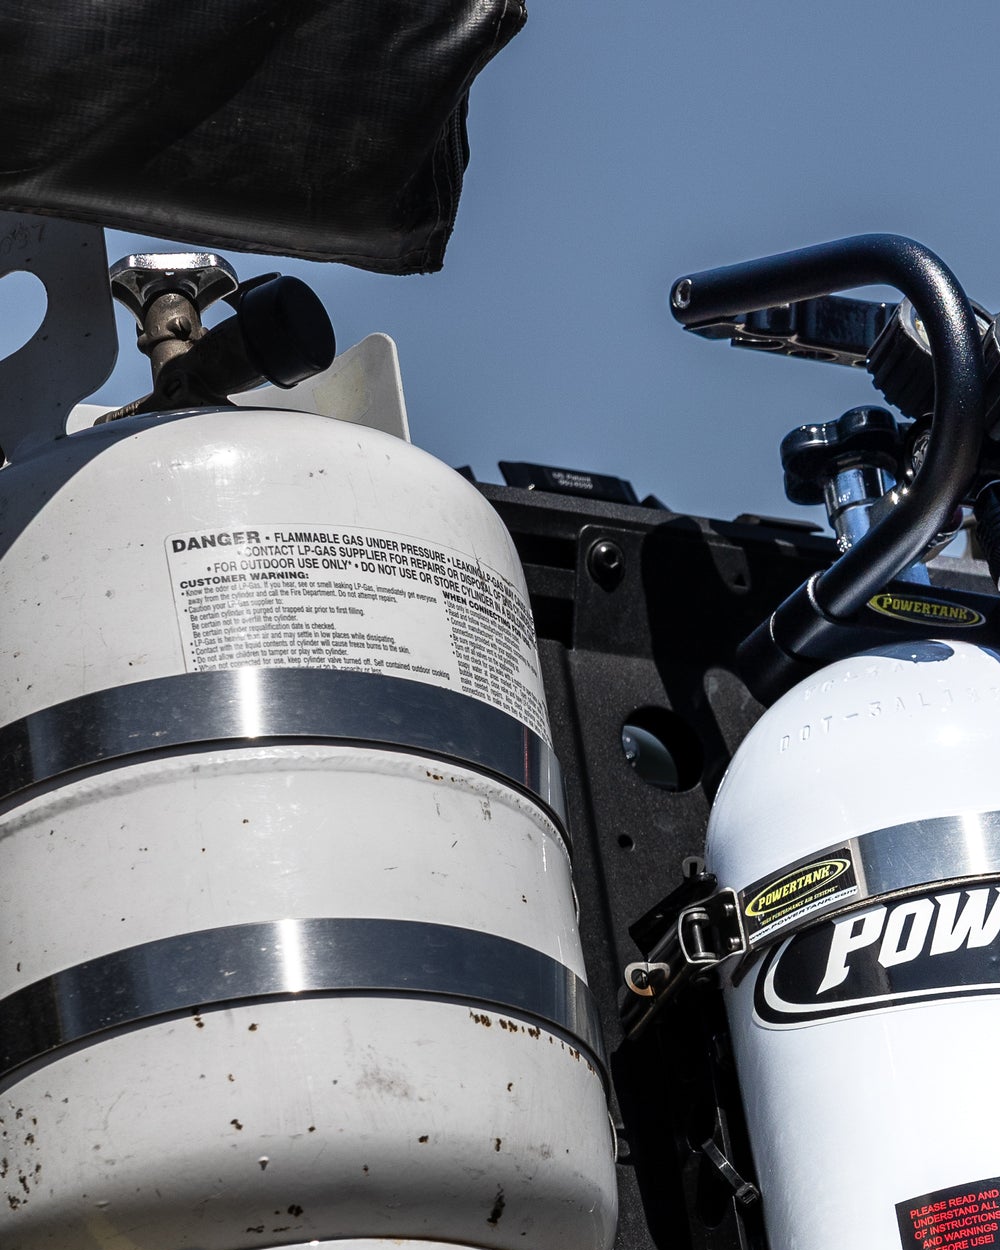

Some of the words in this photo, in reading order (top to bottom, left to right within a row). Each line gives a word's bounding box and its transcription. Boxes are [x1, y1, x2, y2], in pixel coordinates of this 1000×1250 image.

[172, 530, 261, 553] DANGER
[274, 532, 340, 544] FLAMMABLE
[342, 534, 364, 546] GAS
[365, 537, 399, 552] UNDER
[400, 542, 446, 564] PRESSURE
[245, 545, 294, 557] CONTACT
[297, 545, 337, 557] LP-GAS
[339, 547, 388, 563] SUPPLIER
[389, 553, 408, 566] FOR
[411, 557, 446, 576] REPAIRS
[447, 567, 459, 580] OR
[180, 573, 247, 589] CUSTOMER
[250, 571, 309, 580] WARNING:
[213, 561, 237, 573] FOR
[240, 558, 295, 570] OUTDOOR
[298, 558, 320, 569] USE
[361, 561, 376, 573] DO
[377, 564, 397, 577] NOT
[399, 568, 418, 581] USE
[420, 572, 432, 584] OR
[433, 575, 461, 594] STORE
[334, 581, 353, 591] leaking
[290, 588, 301, 596] Fire
[302, 588, 337, 598] Department.
[442, 590, 467, 605] WHEN
[882, 597, 968, 620] POWERTANK
[758, 864, 831, 911] POWERTANK
[910, 1201, 947, 1219] PLEASE
[949, 1194, 976, 1207] READ
[978, 1189, 1000, 1201] AND
[914, 1204, 979, 1229] UNDERSTAND
[981, 1201, 999, 1211] ALL
[914, 1230, 928, 1240] OF
[923, 1236, 943, 1249] AND
[944, 1222, 999, 1241] WARNINGS
[971, 1234, 995, 1246] USE!
